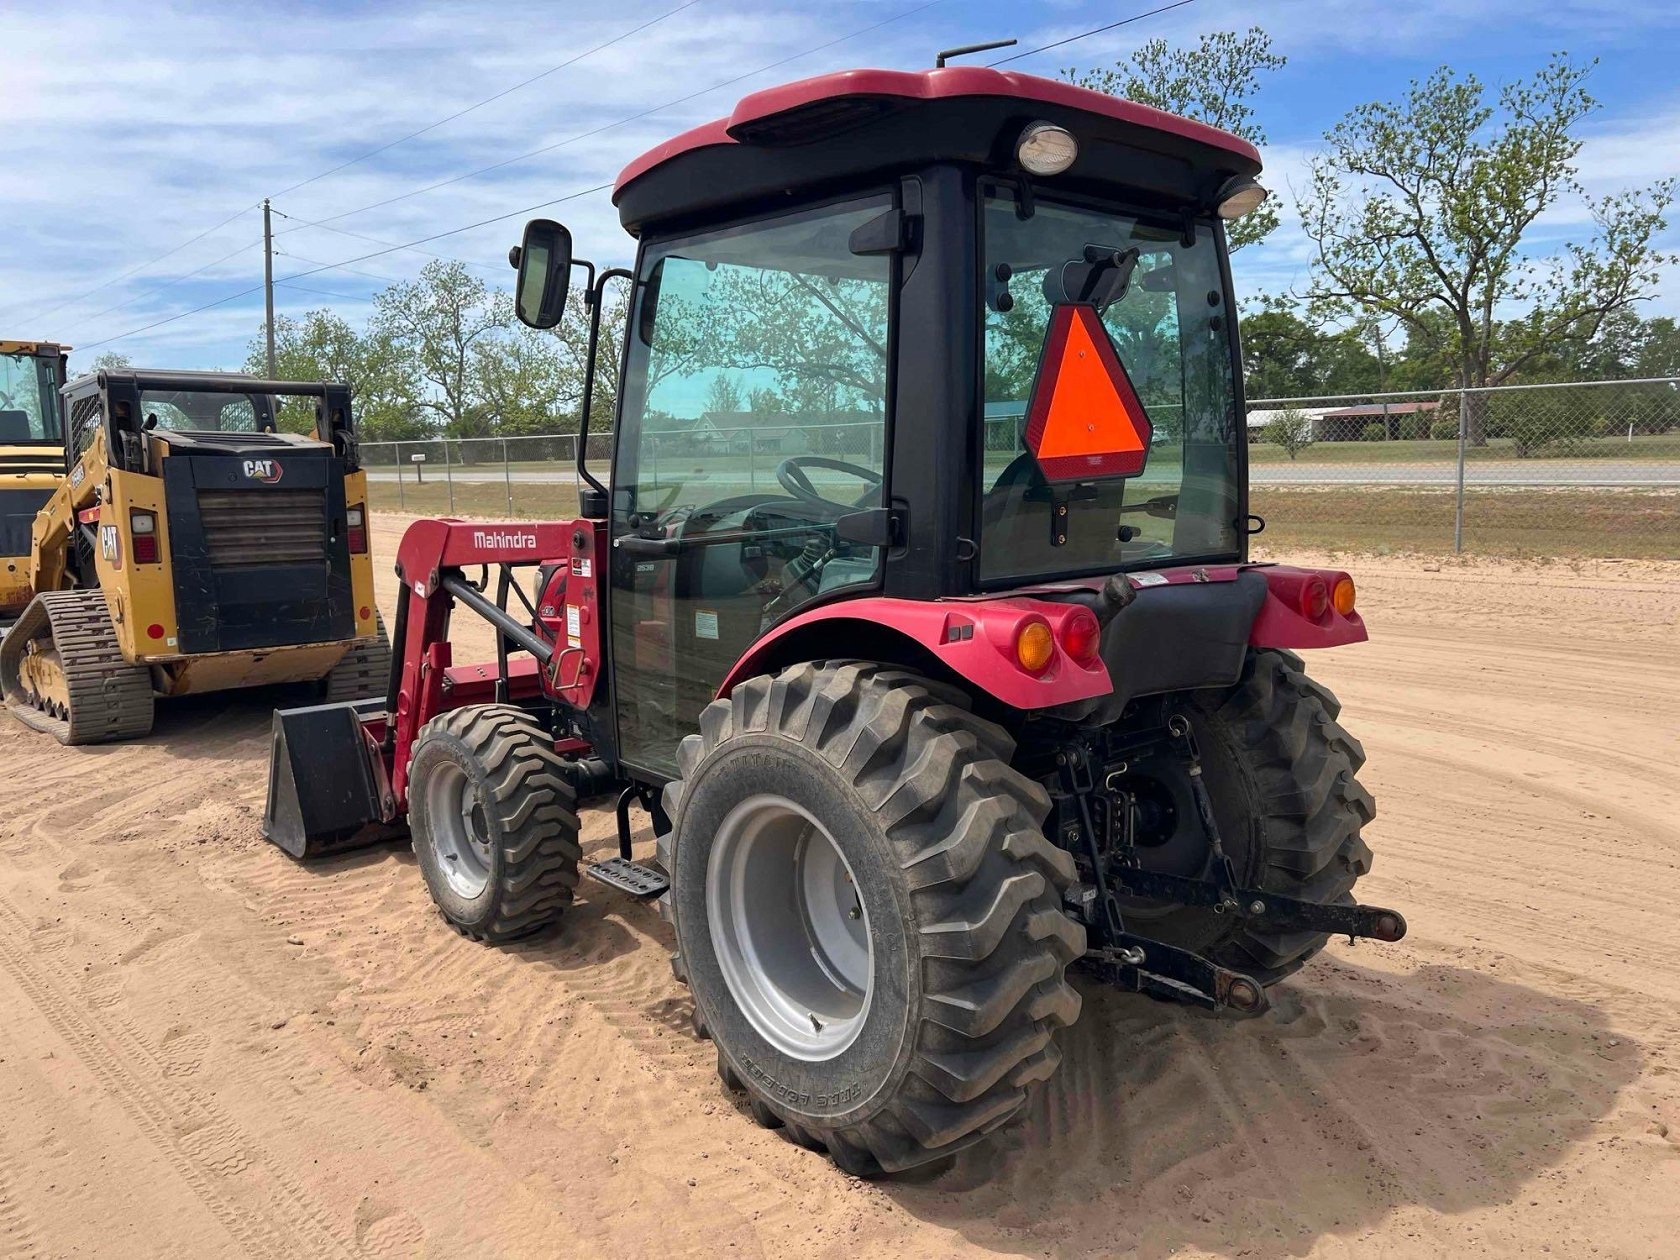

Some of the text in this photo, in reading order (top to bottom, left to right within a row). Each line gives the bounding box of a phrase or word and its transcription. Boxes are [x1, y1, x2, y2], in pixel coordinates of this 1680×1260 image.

[243, 460, 272, 477] CAT
[102, 526, 118, 560] CAT
[473, 530, 537, 549] Mahindra
[817, 1082, 862, 1107] TRAC
